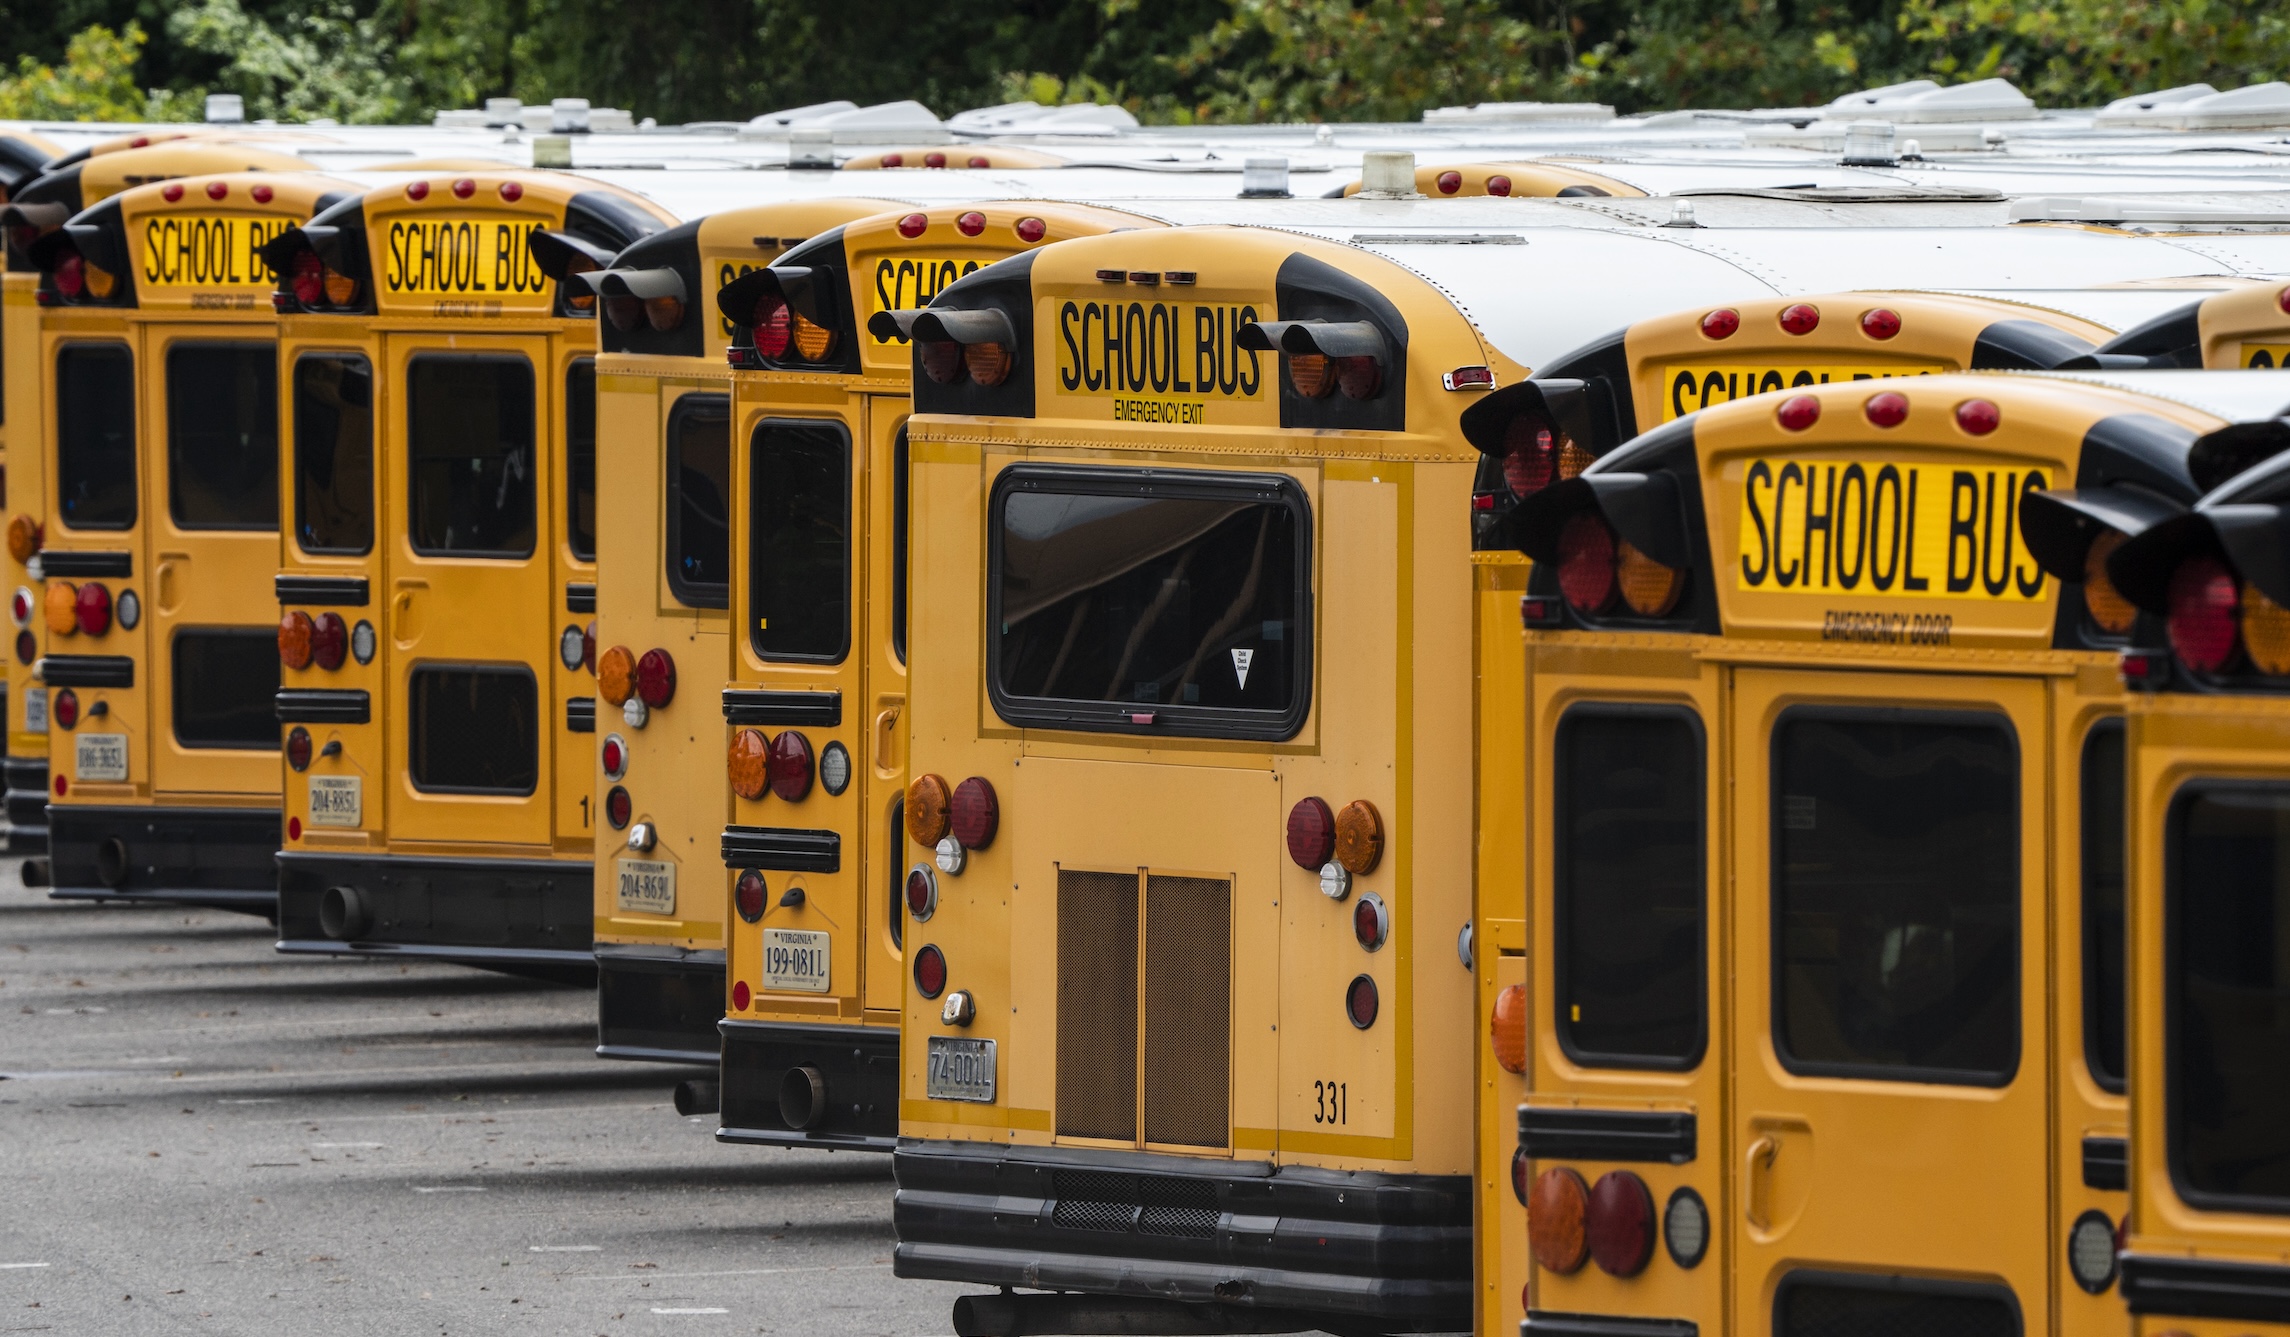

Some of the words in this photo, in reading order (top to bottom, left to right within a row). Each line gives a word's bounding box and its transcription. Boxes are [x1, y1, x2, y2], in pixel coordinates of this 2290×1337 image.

[146, 218, 240, 283] SCHOOL
[388, 222, 485, 291] SCHOOL
[1061, 301, 1190, 393] SCHOOL
[1195, 306, 1260, 396] BUS
[1114, 399, 1180, 423] EMERGENCY
[1182, 403, 1204, 425] EXIT
[1742, 460, 1929, 591] SCHOOL
[1822, 610, 1912, 645] EMERGENCY
[1910, 615, 1953, 646] DOOR
[620, 873, 672, 901] 204-869L
[780, 932, 812, 945] VIRGINIA
[766, 946, 825, 977] 199-081L
[945, 1040, 980, 1053] VIRGINIA
[931, 1052, 991, 1087] 74-001L
[1314, 1080, 1346, 1125] 331
